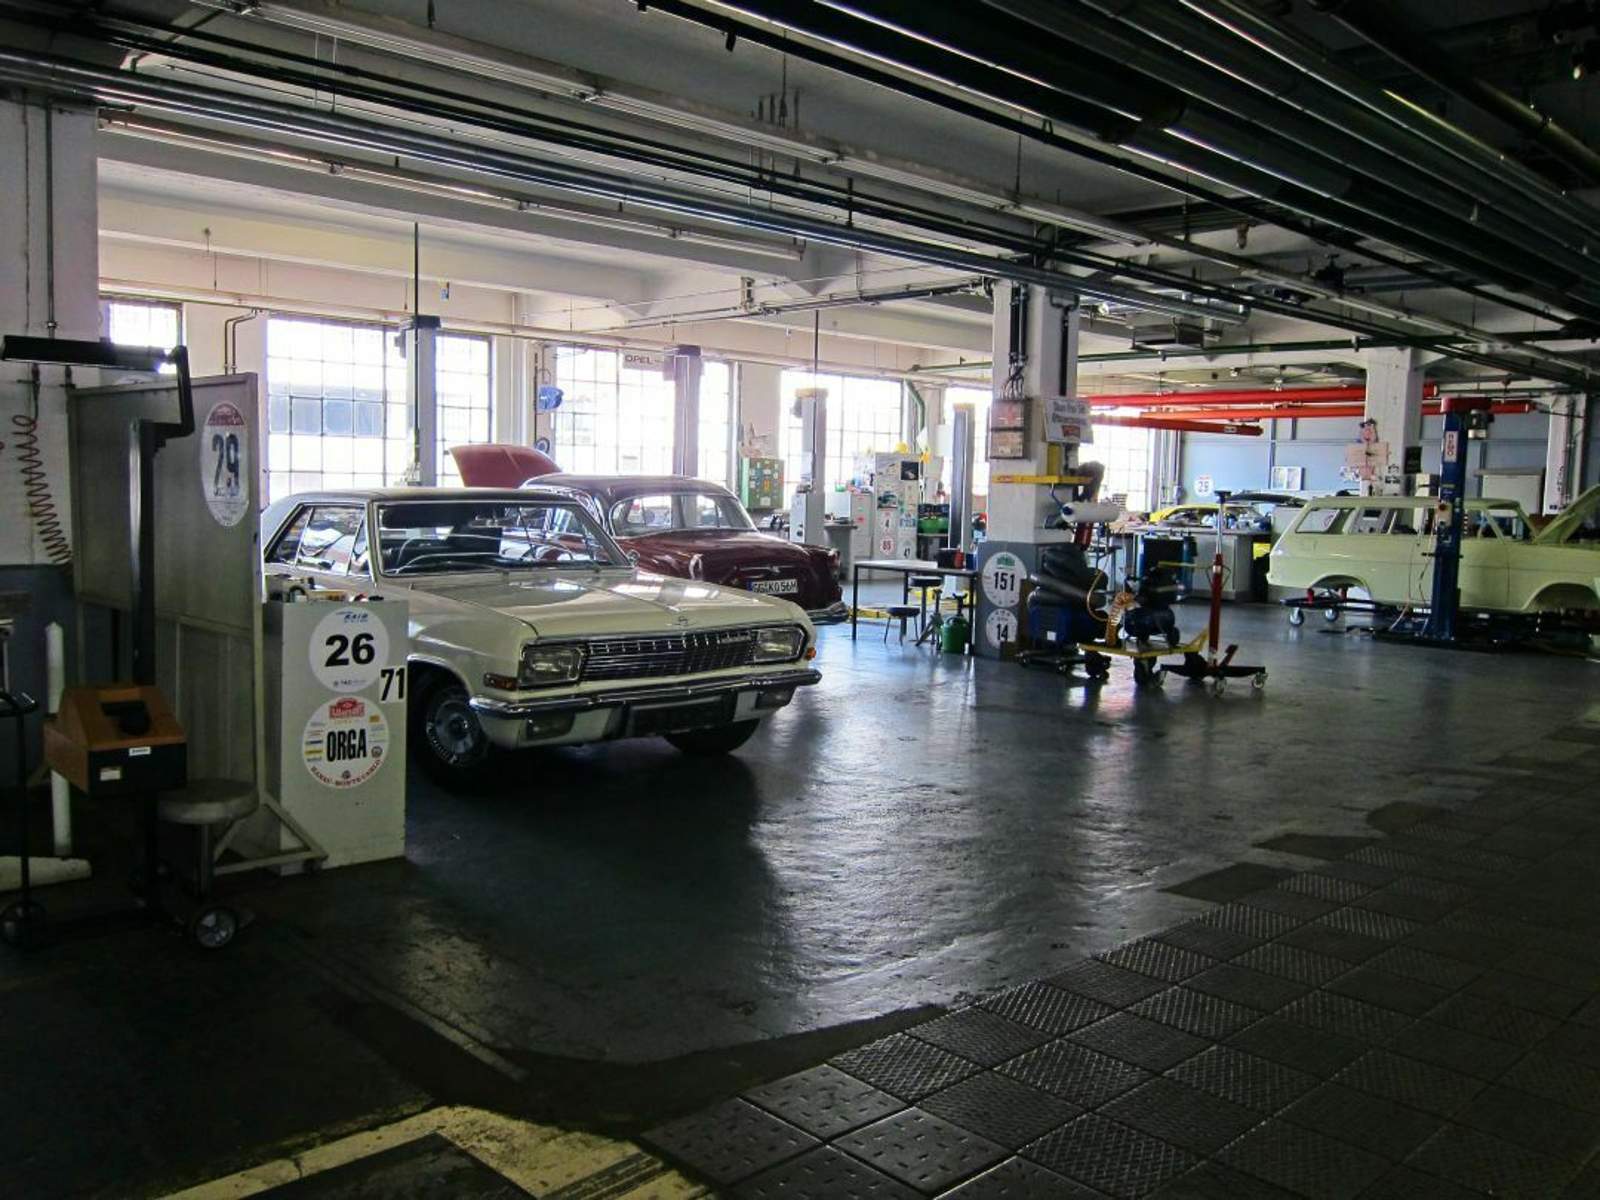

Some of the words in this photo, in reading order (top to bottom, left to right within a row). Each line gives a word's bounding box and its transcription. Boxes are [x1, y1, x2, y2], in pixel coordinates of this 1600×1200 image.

[211, 434, 240, 497] 29
[993, 571, 1016, 592] 151
[996, 623, 1009, 641] 14
[325, 632, 376, 668] 26
[380, 667, 405, 702] 71
[326, 728, 367, 762] ORGA
